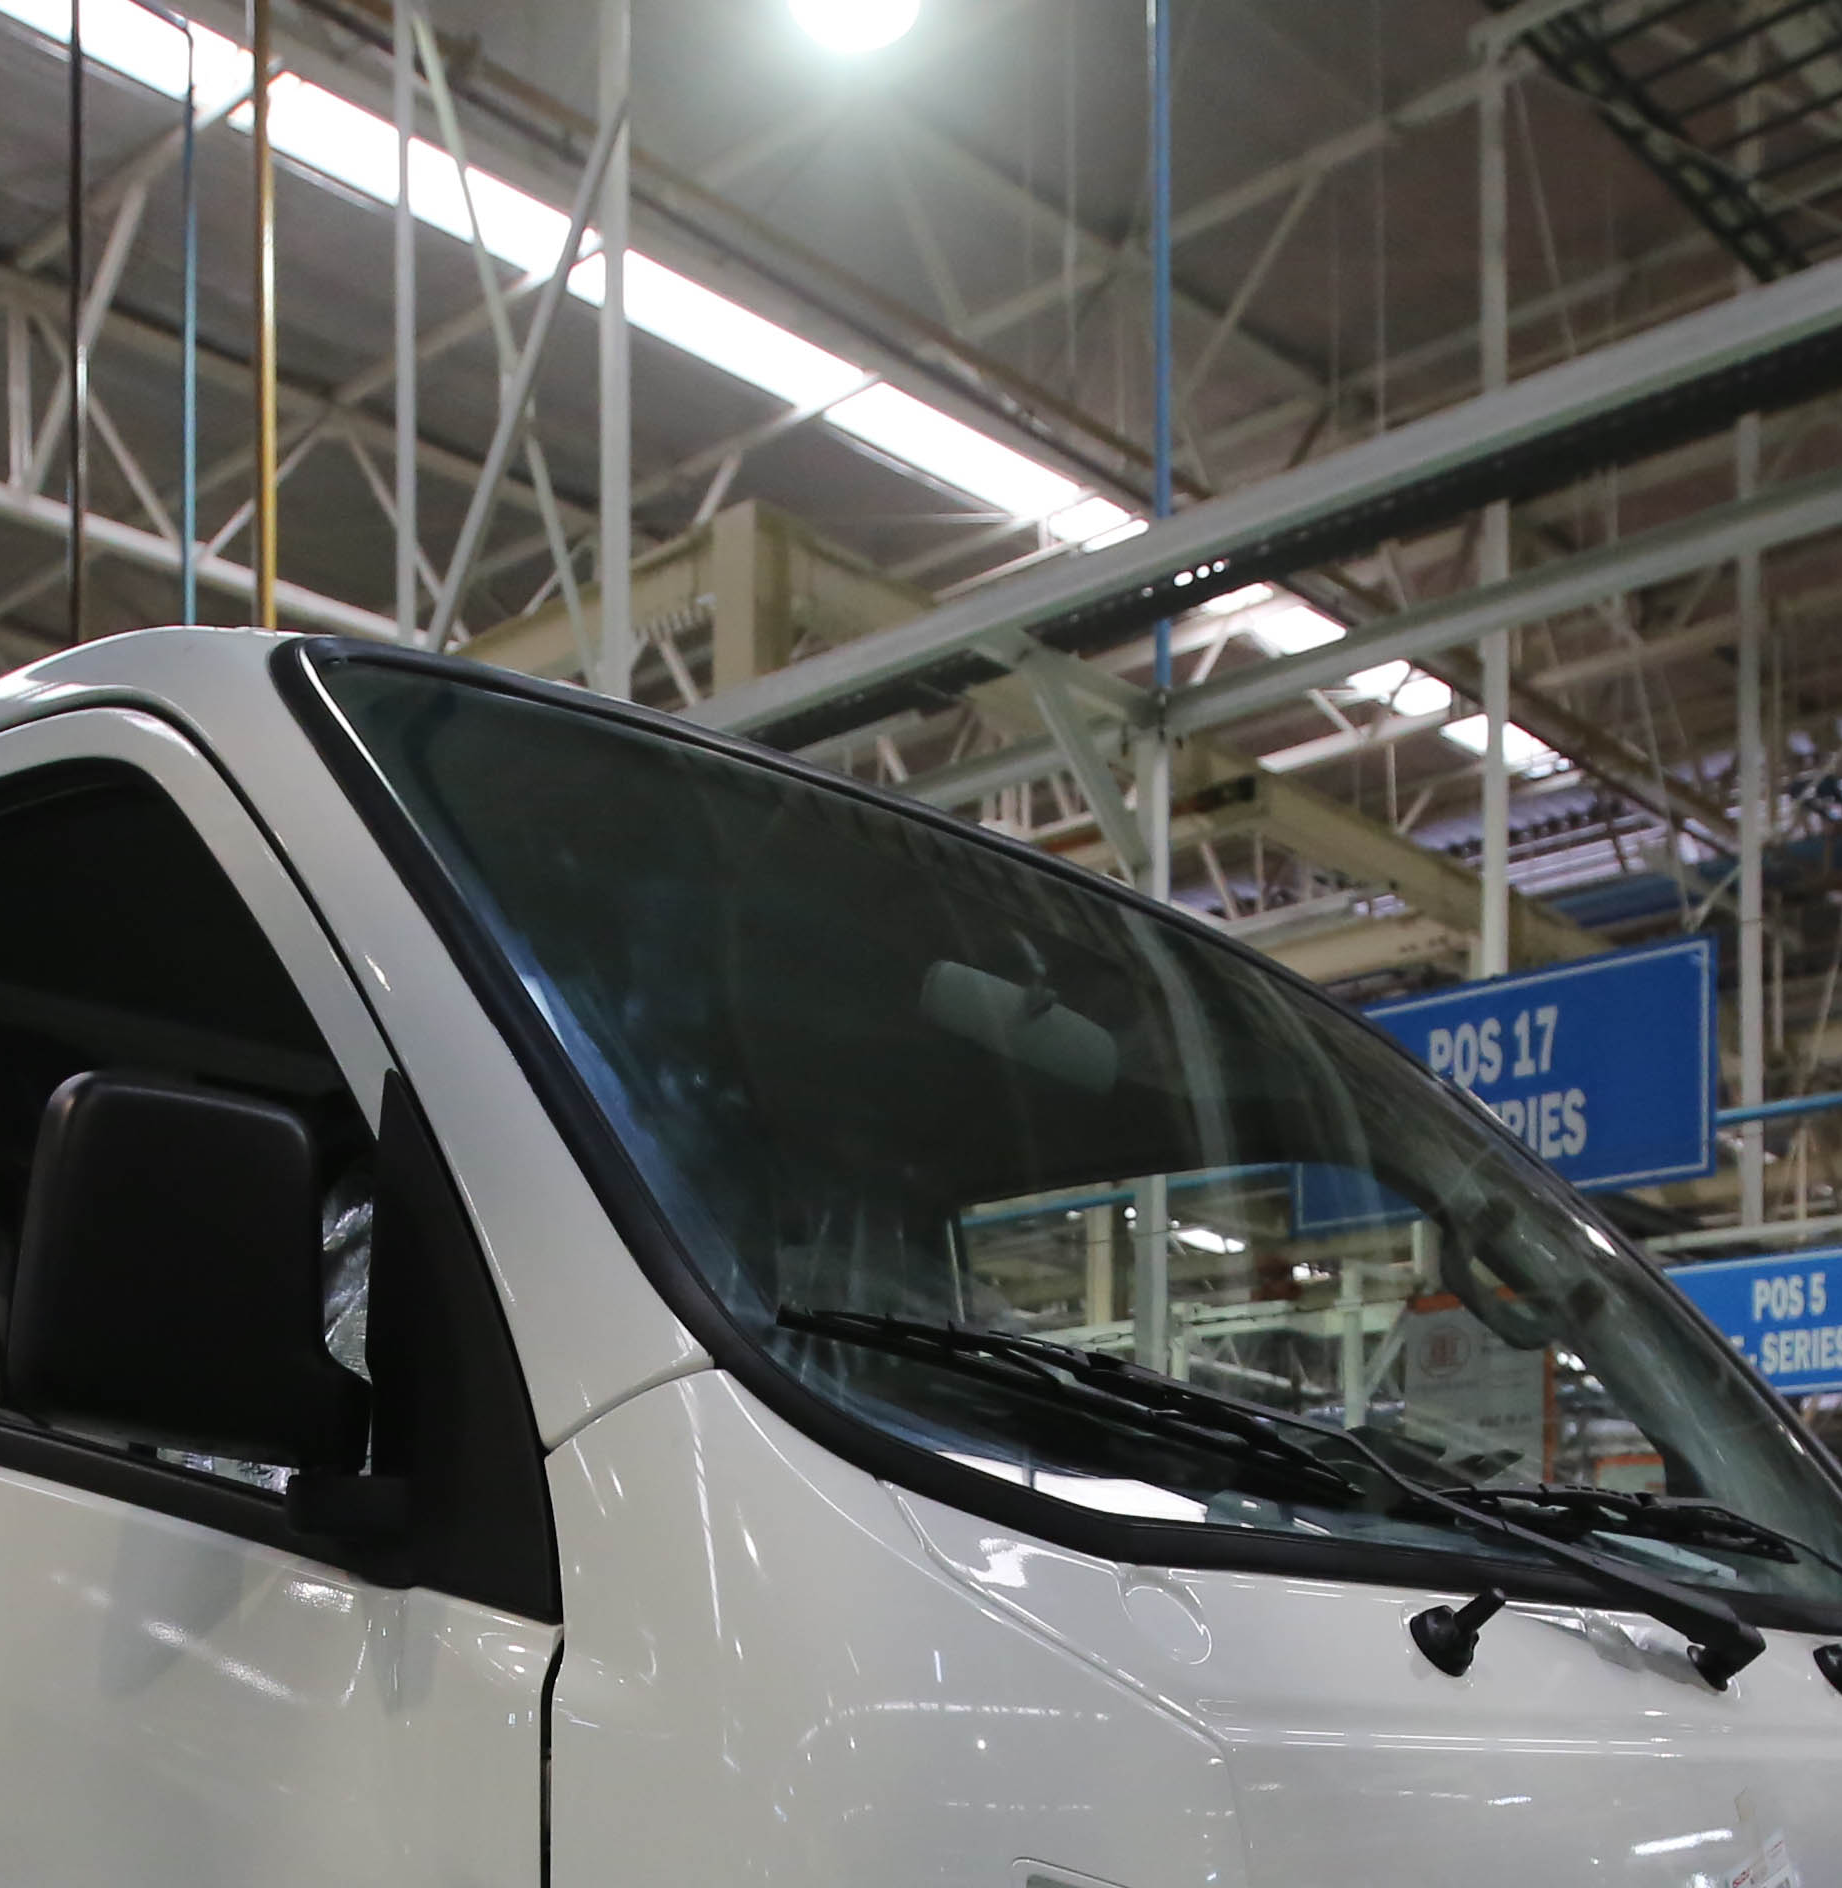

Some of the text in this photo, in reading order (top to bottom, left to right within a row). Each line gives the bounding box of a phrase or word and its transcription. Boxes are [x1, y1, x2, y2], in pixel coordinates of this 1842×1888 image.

[1428, 1004, 1558, 1090] POS 17
[1489, 1087, 1588, 1160] RIES
[1752, 1271, 1827, 1323] POS 5
